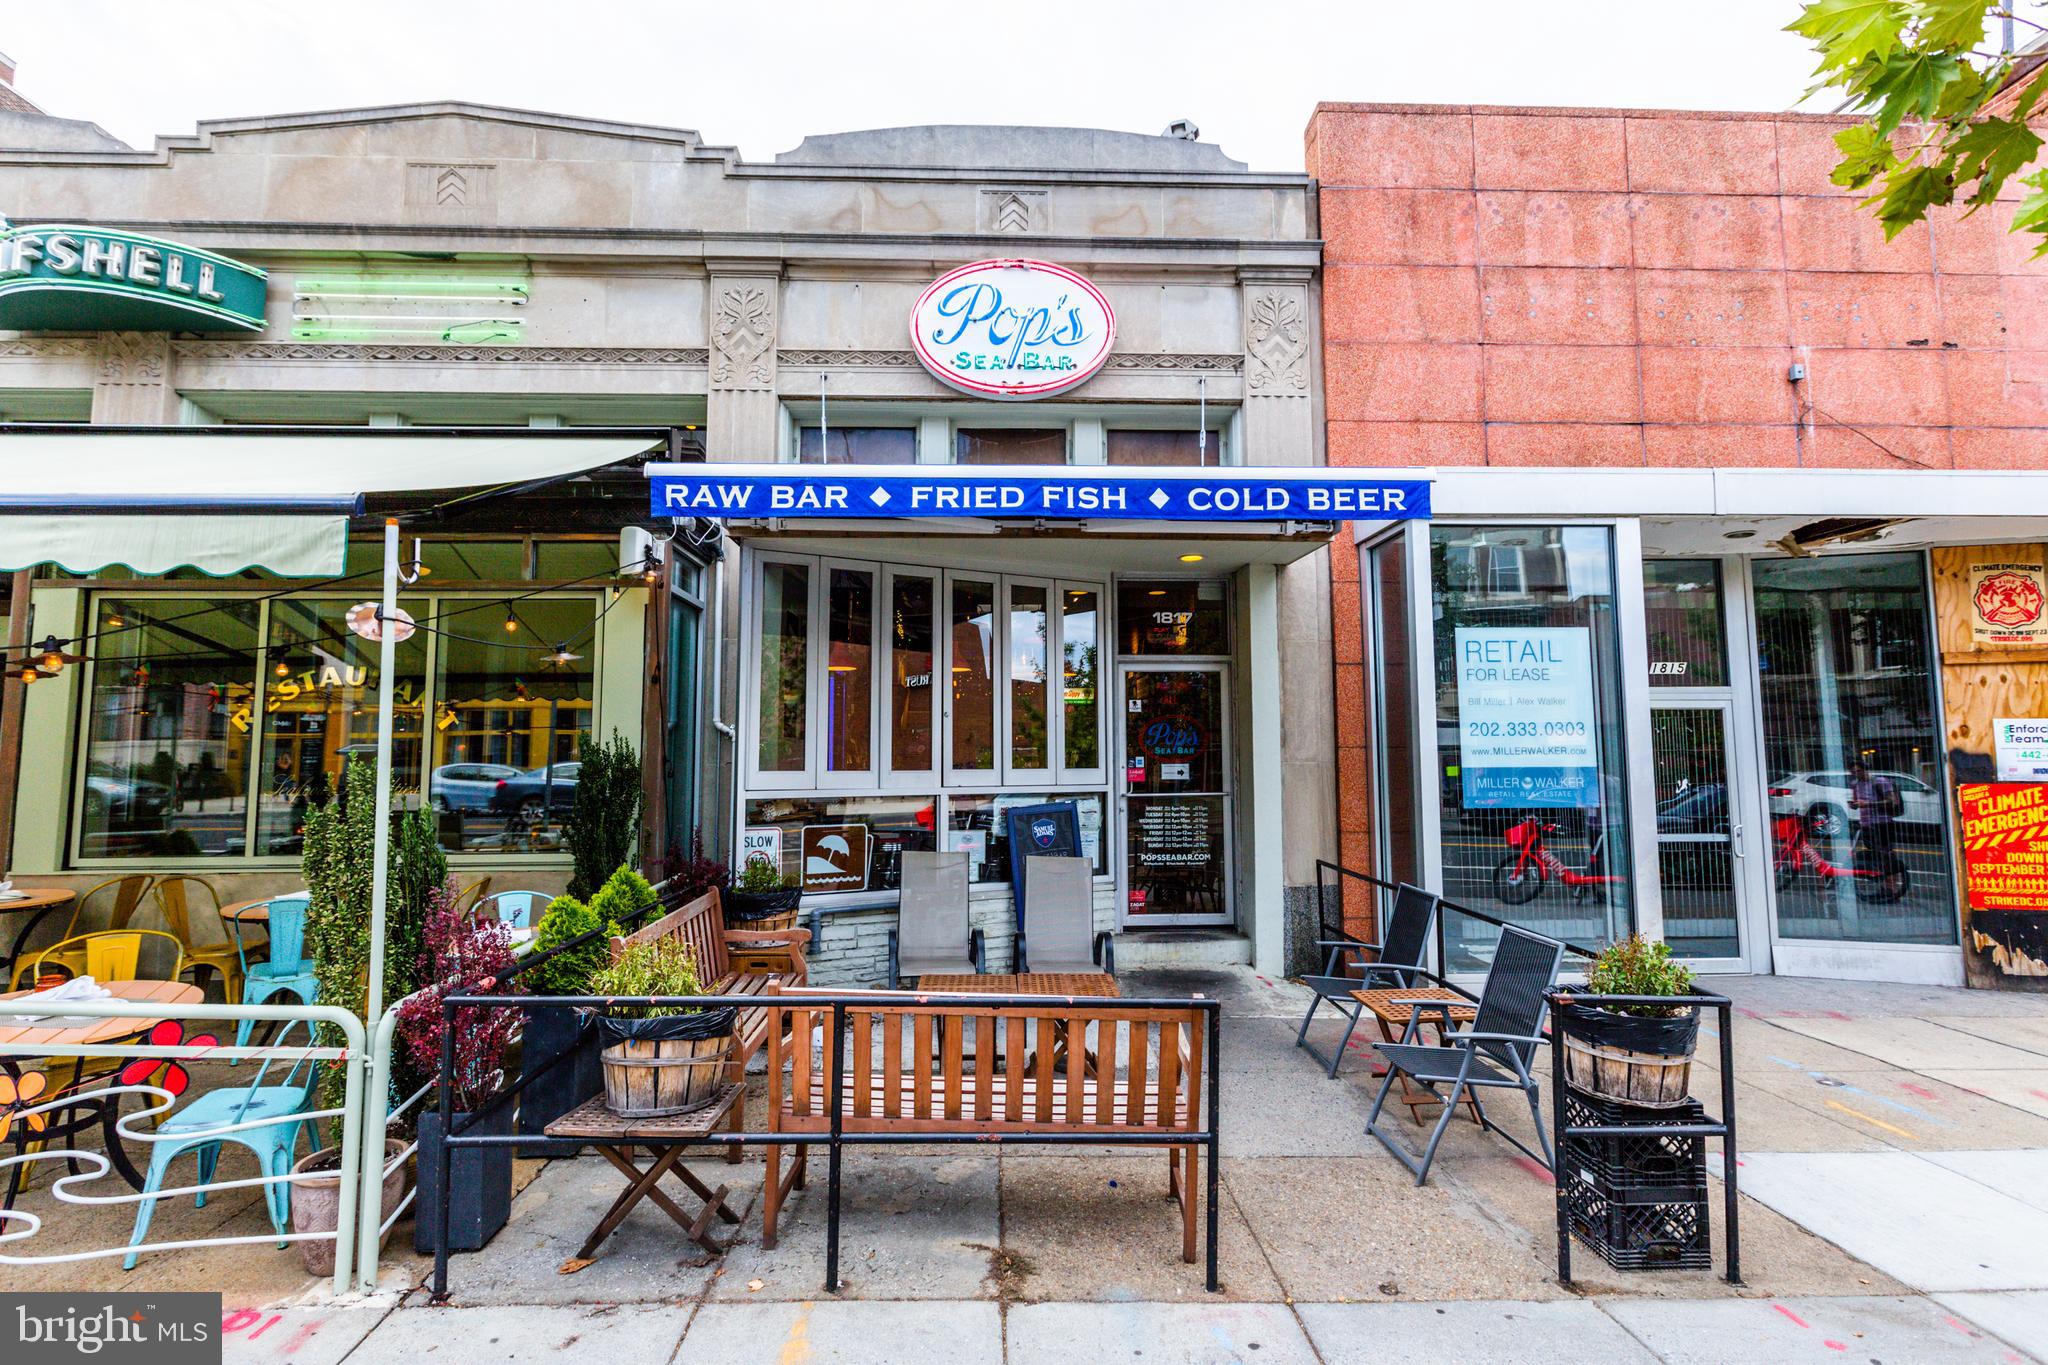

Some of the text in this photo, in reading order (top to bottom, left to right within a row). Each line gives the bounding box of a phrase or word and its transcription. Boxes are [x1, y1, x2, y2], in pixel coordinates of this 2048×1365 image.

[0, 234, 225, 303] FSHELL
[932, 283, 1096, 369] Pop's
[956, 351, 1078, 370] SEA BAR
[665, 484, 1407, 511] RAW BAR FRIED FISH COLD BEER
[2001, 564, 2043, 572] EMERGENCY
[1152, 611, 1193, 624] 1817
[1465, 639, 1562, 663] RETAIL
[1652, 663, 1685, 673] 1815
[1466, 668, 1551, 681] FOR LEASE
[1468, 696, 1566, 706] Bill Miller Alex Walker
[1469, 721, 1586, 737] 202.333.0303
[2009, 735, 2045, 743] Team
[1477, 777, 1585, 789] MILLER WALKER
[1543, 790, 1572, 798] ESTATE
[1977, 786, 2044, 815] CLIMATE
[1034, 824, 1056, 834] SAMUEL
[744, 836, 773, 848] SLOW
[1141, 853, 1211, 861] POPSSEABAR.COM
[2007, 852, 2044, 863] DOWN
[1972, 863, 2045, 875] SEPTEMBER
